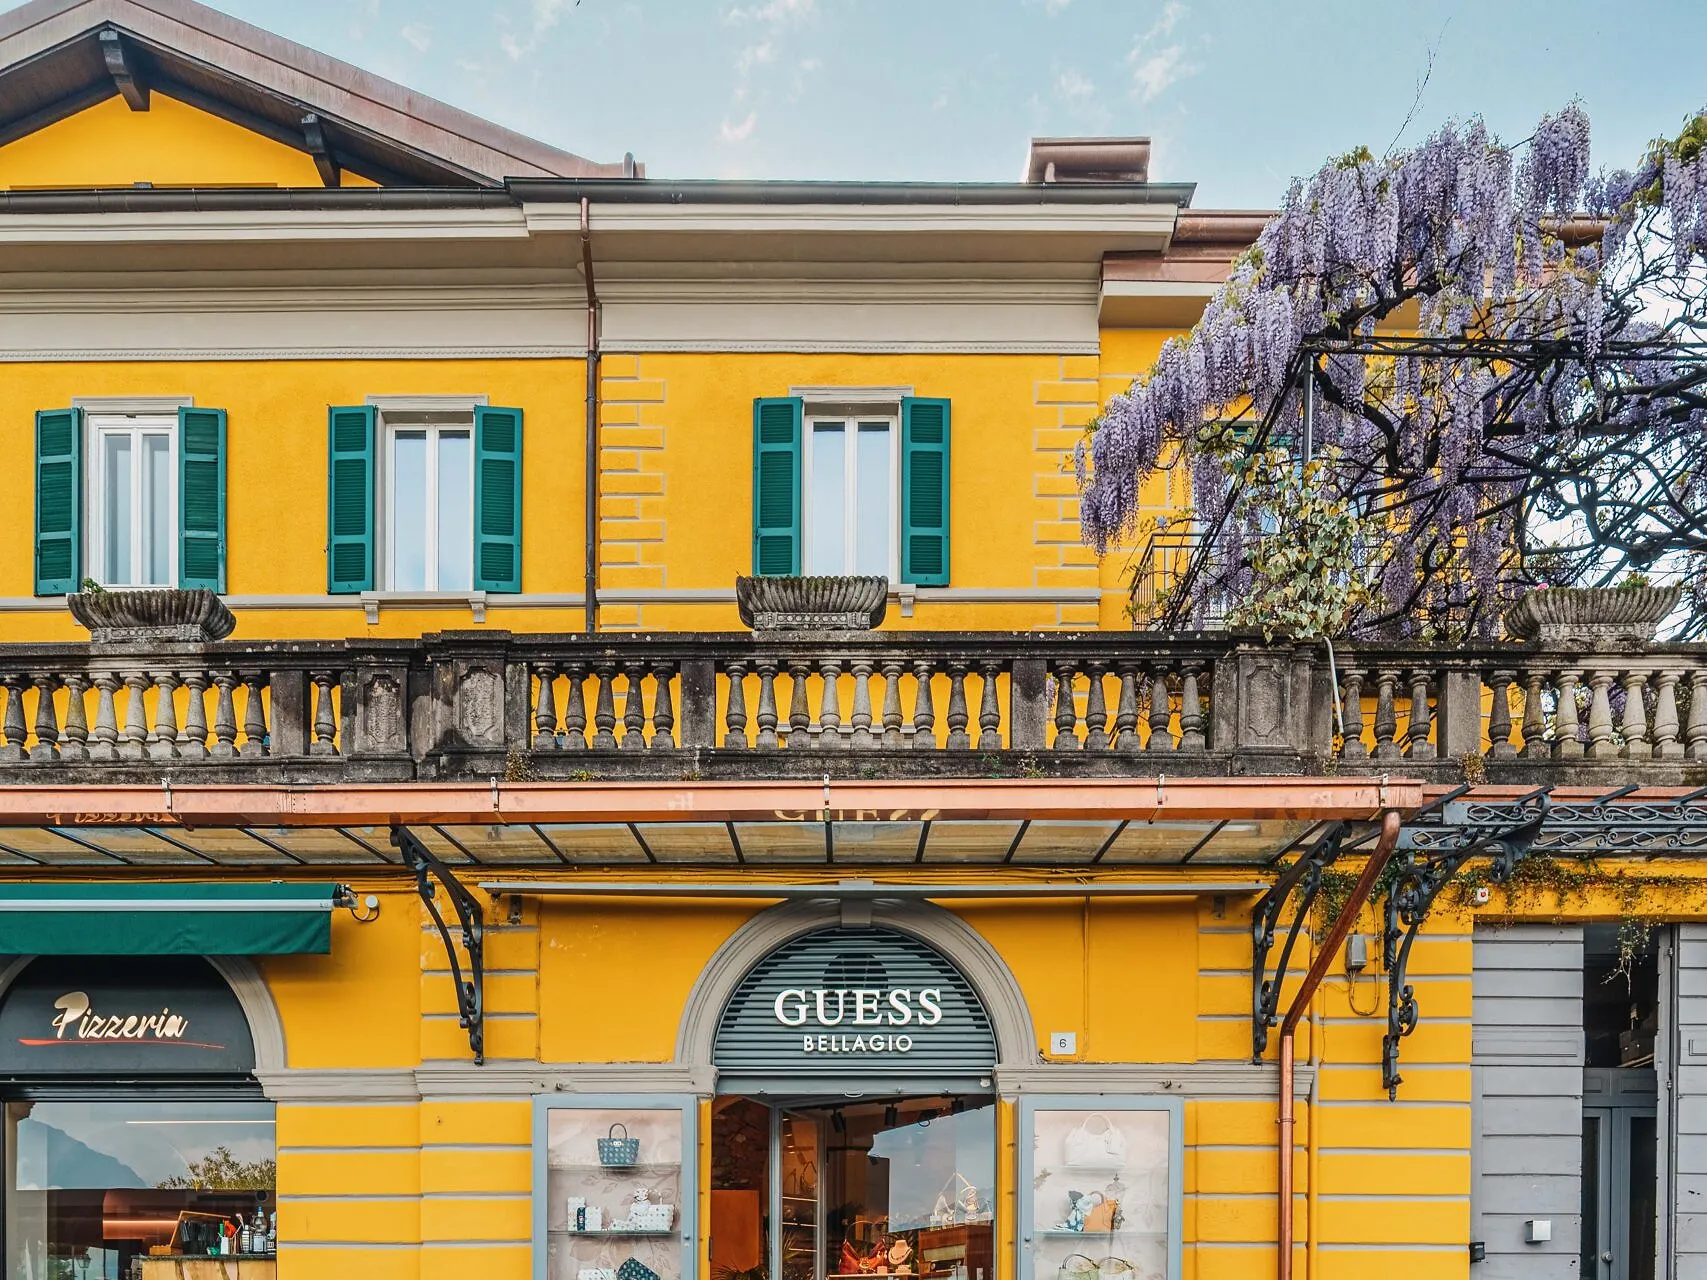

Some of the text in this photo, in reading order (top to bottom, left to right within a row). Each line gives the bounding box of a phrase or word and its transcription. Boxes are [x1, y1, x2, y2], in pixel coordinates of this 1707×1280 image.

[52, 991, 188, 1039] Pizzeria
[774, 988, 943, 1026] GUESS
[803, 1034, 913, 1052] BELLAGIO
[1059, 1038, 1067, 1048] 6
